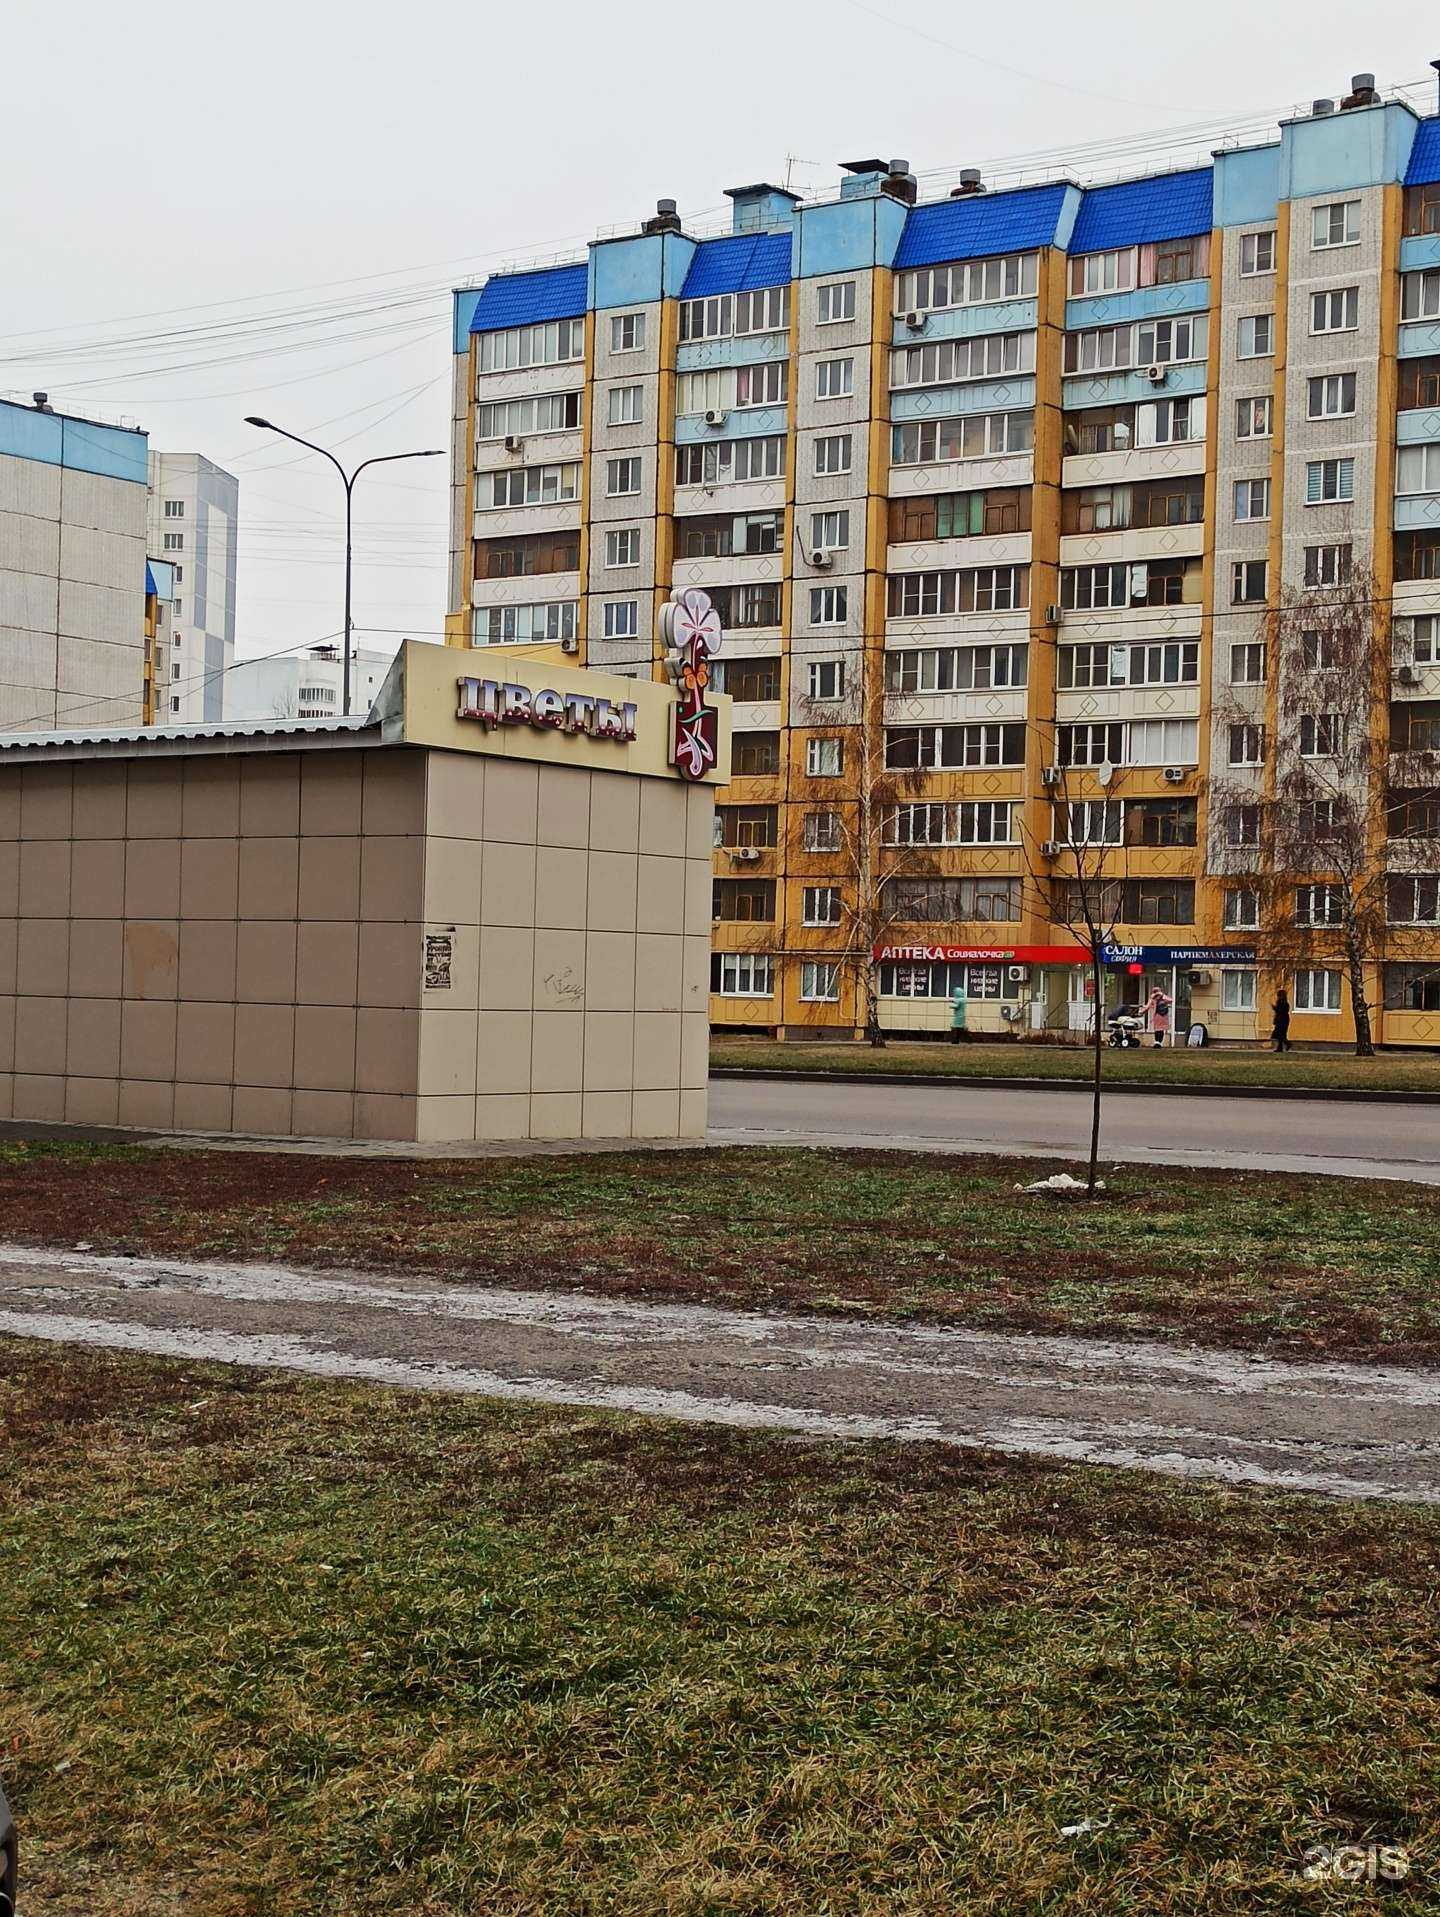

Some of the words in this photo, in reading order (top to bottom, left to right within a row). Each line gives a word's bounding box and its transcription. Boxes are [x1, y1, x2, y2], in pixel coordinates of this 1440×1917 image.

[881, 946, 945, 960] АПТЕКА
[1105, 945, 1143, 956] САЛОН
[1170, 951, 1256, 960] ПАРИКМАХЕРСКАЯ
